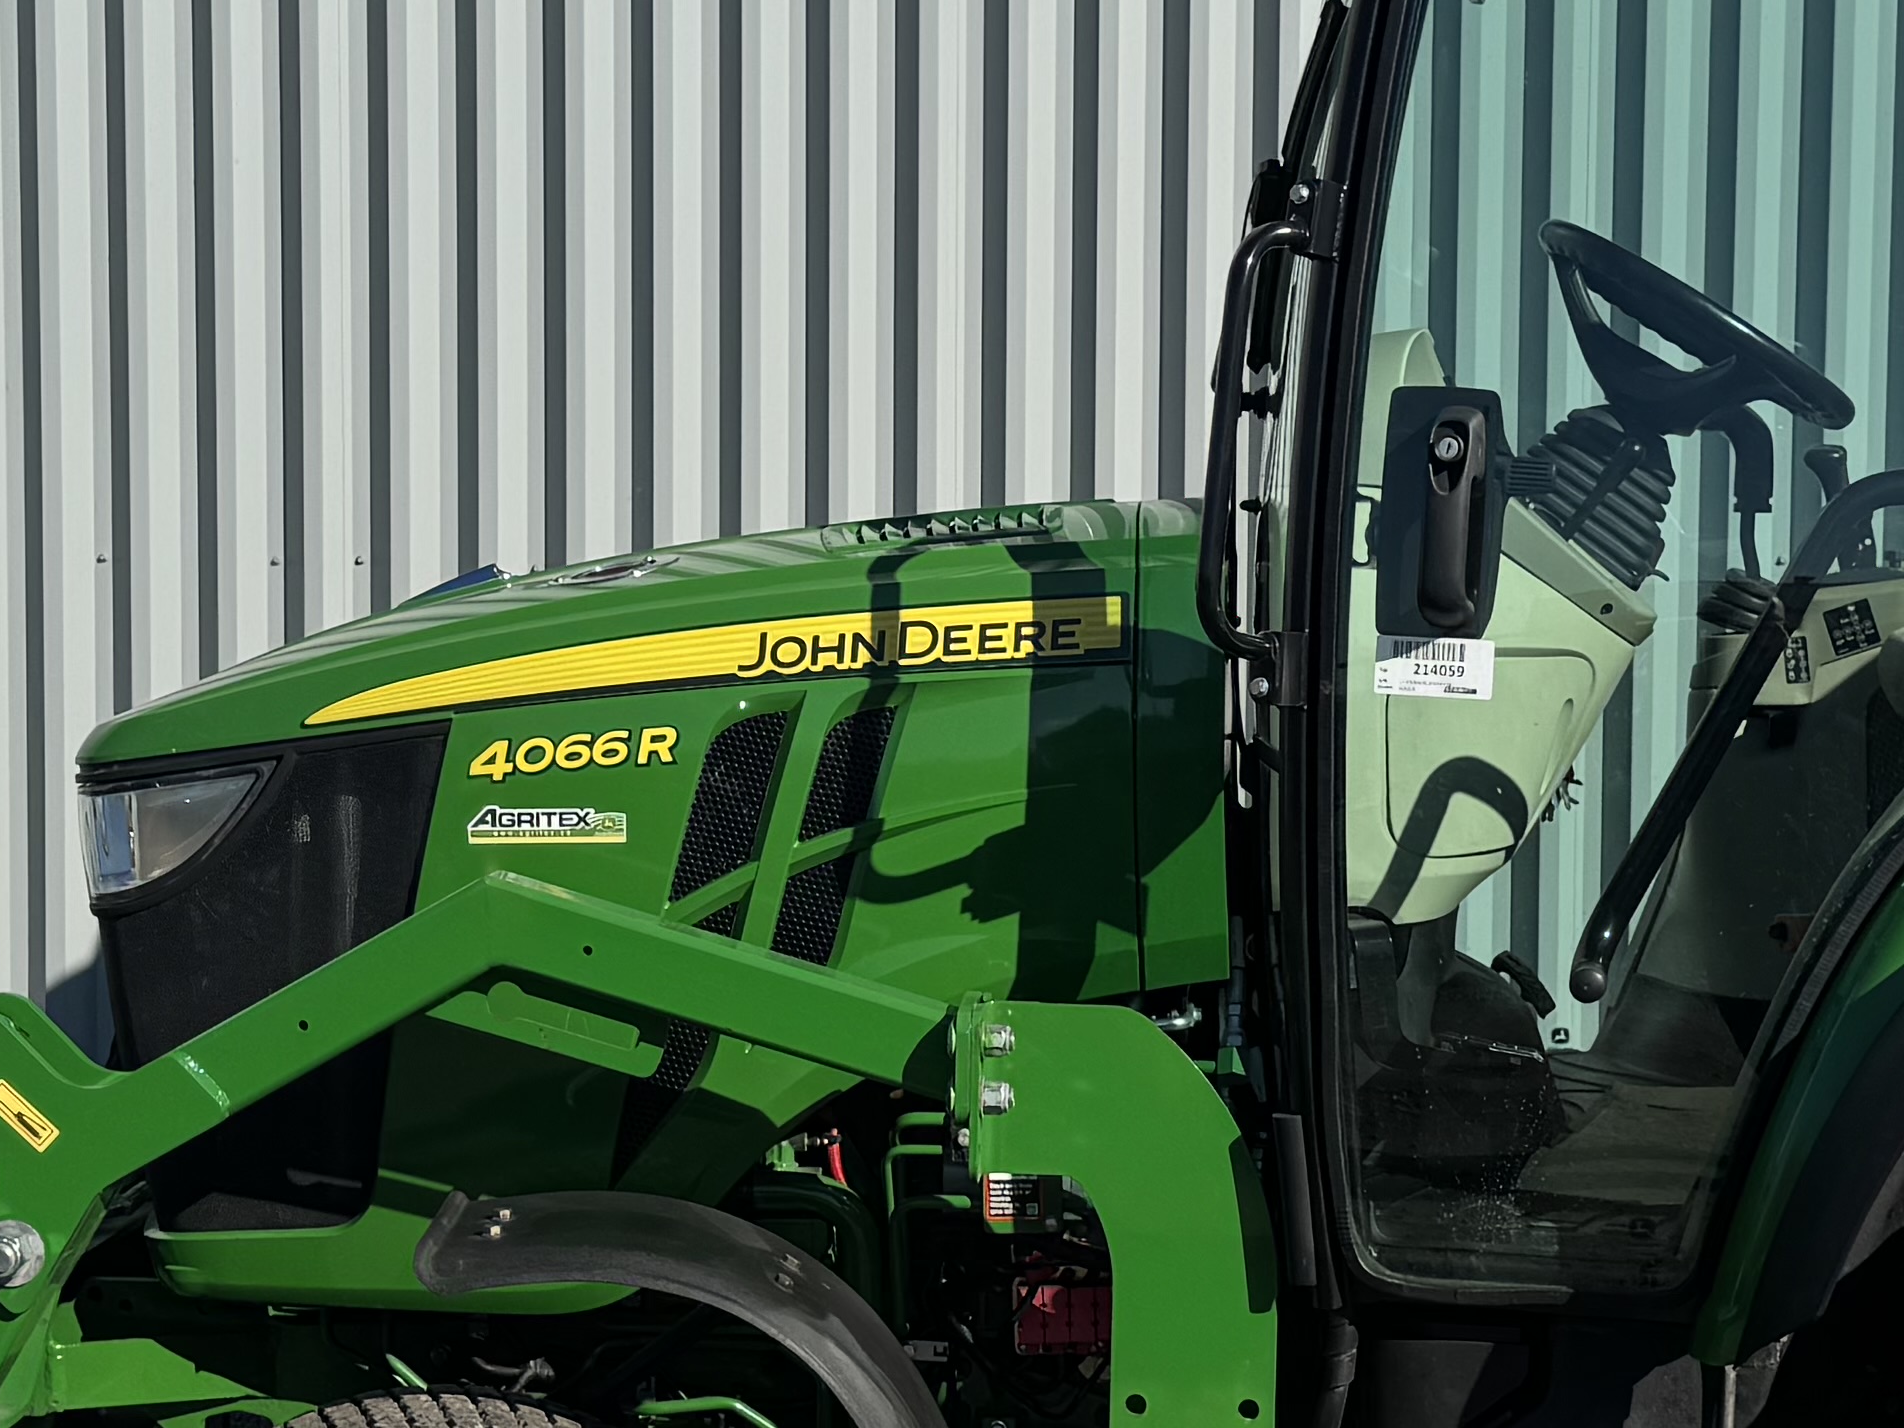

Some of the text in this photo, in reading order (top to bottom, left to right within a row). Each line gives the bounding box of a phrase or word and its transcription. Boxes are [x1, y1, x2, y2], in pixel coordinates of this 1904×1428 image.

[737, 618, 1082, 672] JOHN DEERE
[1413, 663, 1465, 677] 214059
[471, 807, 592, 828] AGRITEX
